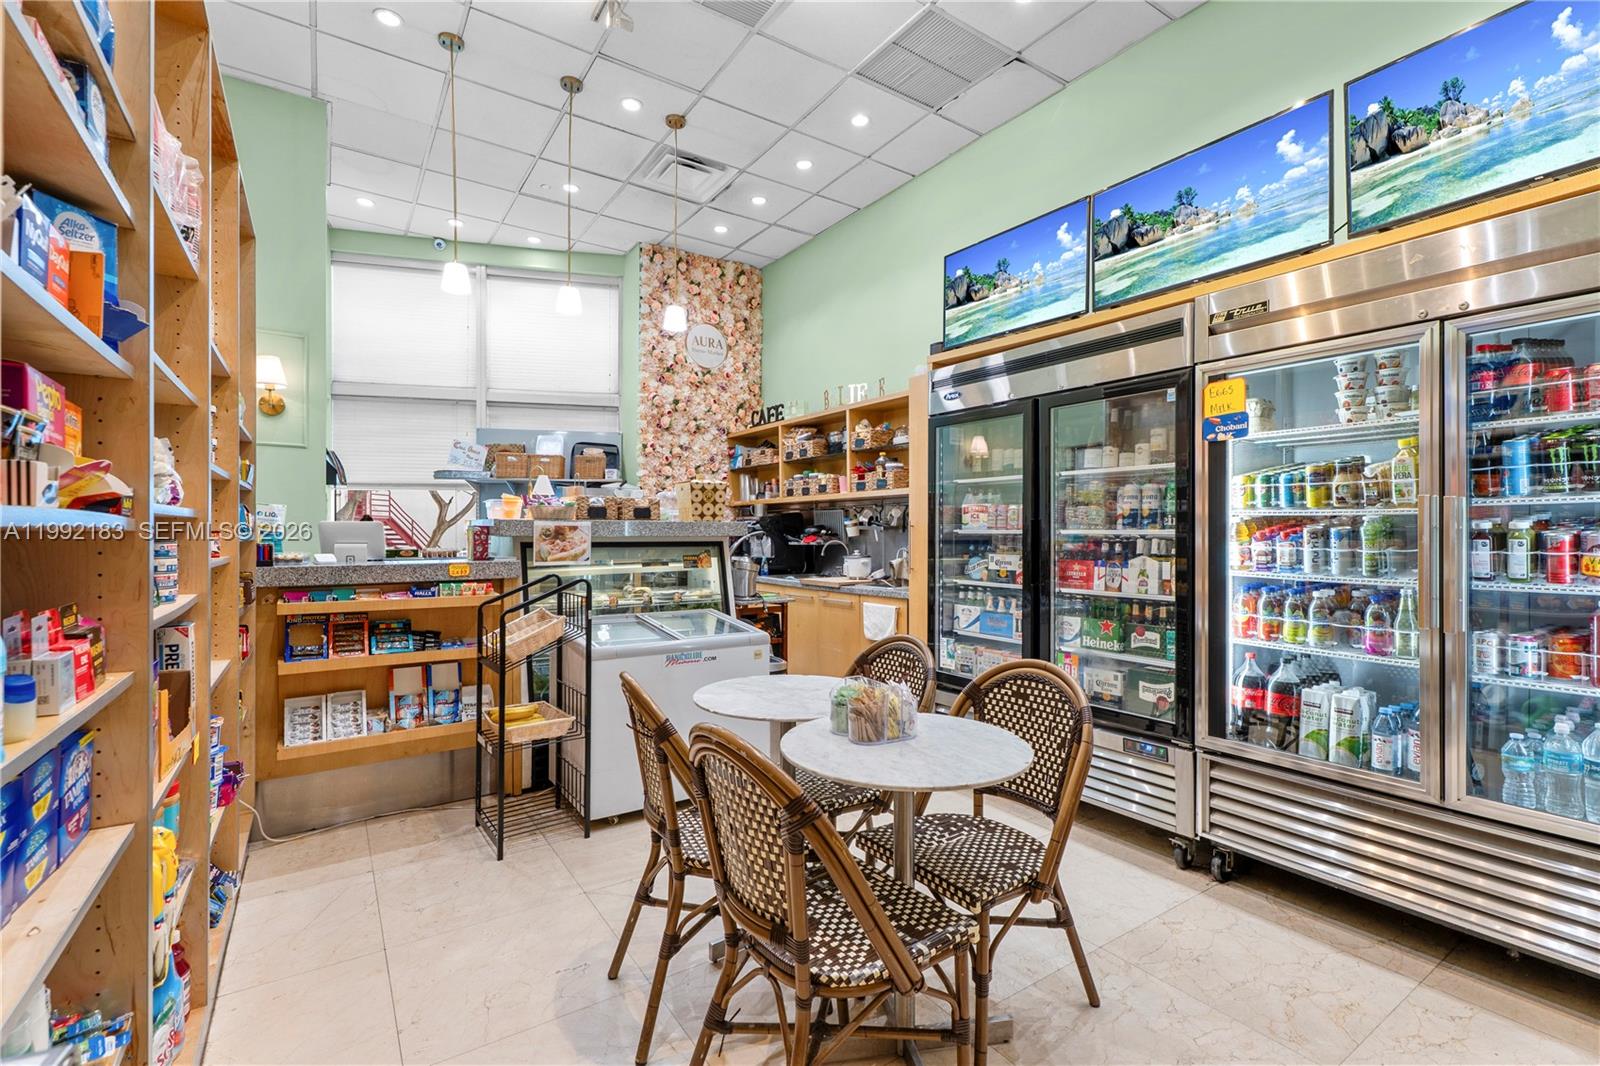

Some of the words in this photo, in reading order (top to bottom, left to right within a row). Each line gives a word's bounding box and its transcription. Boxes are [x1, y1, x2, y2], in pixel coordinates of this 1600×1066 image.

[60, 217, 89, 231] Alka-
[58, 225, 96, 243] Seltzer
[693, 336, 723, 350] AURA
[1209, 385, 1234, 399] EGGS
[1210, 402, 1233, 415] MILK
[750, 404, 784, 428] CAFE
[1215, 421, 1248, 432] Chobani
[1394, 472, 1412, 480] VERA
